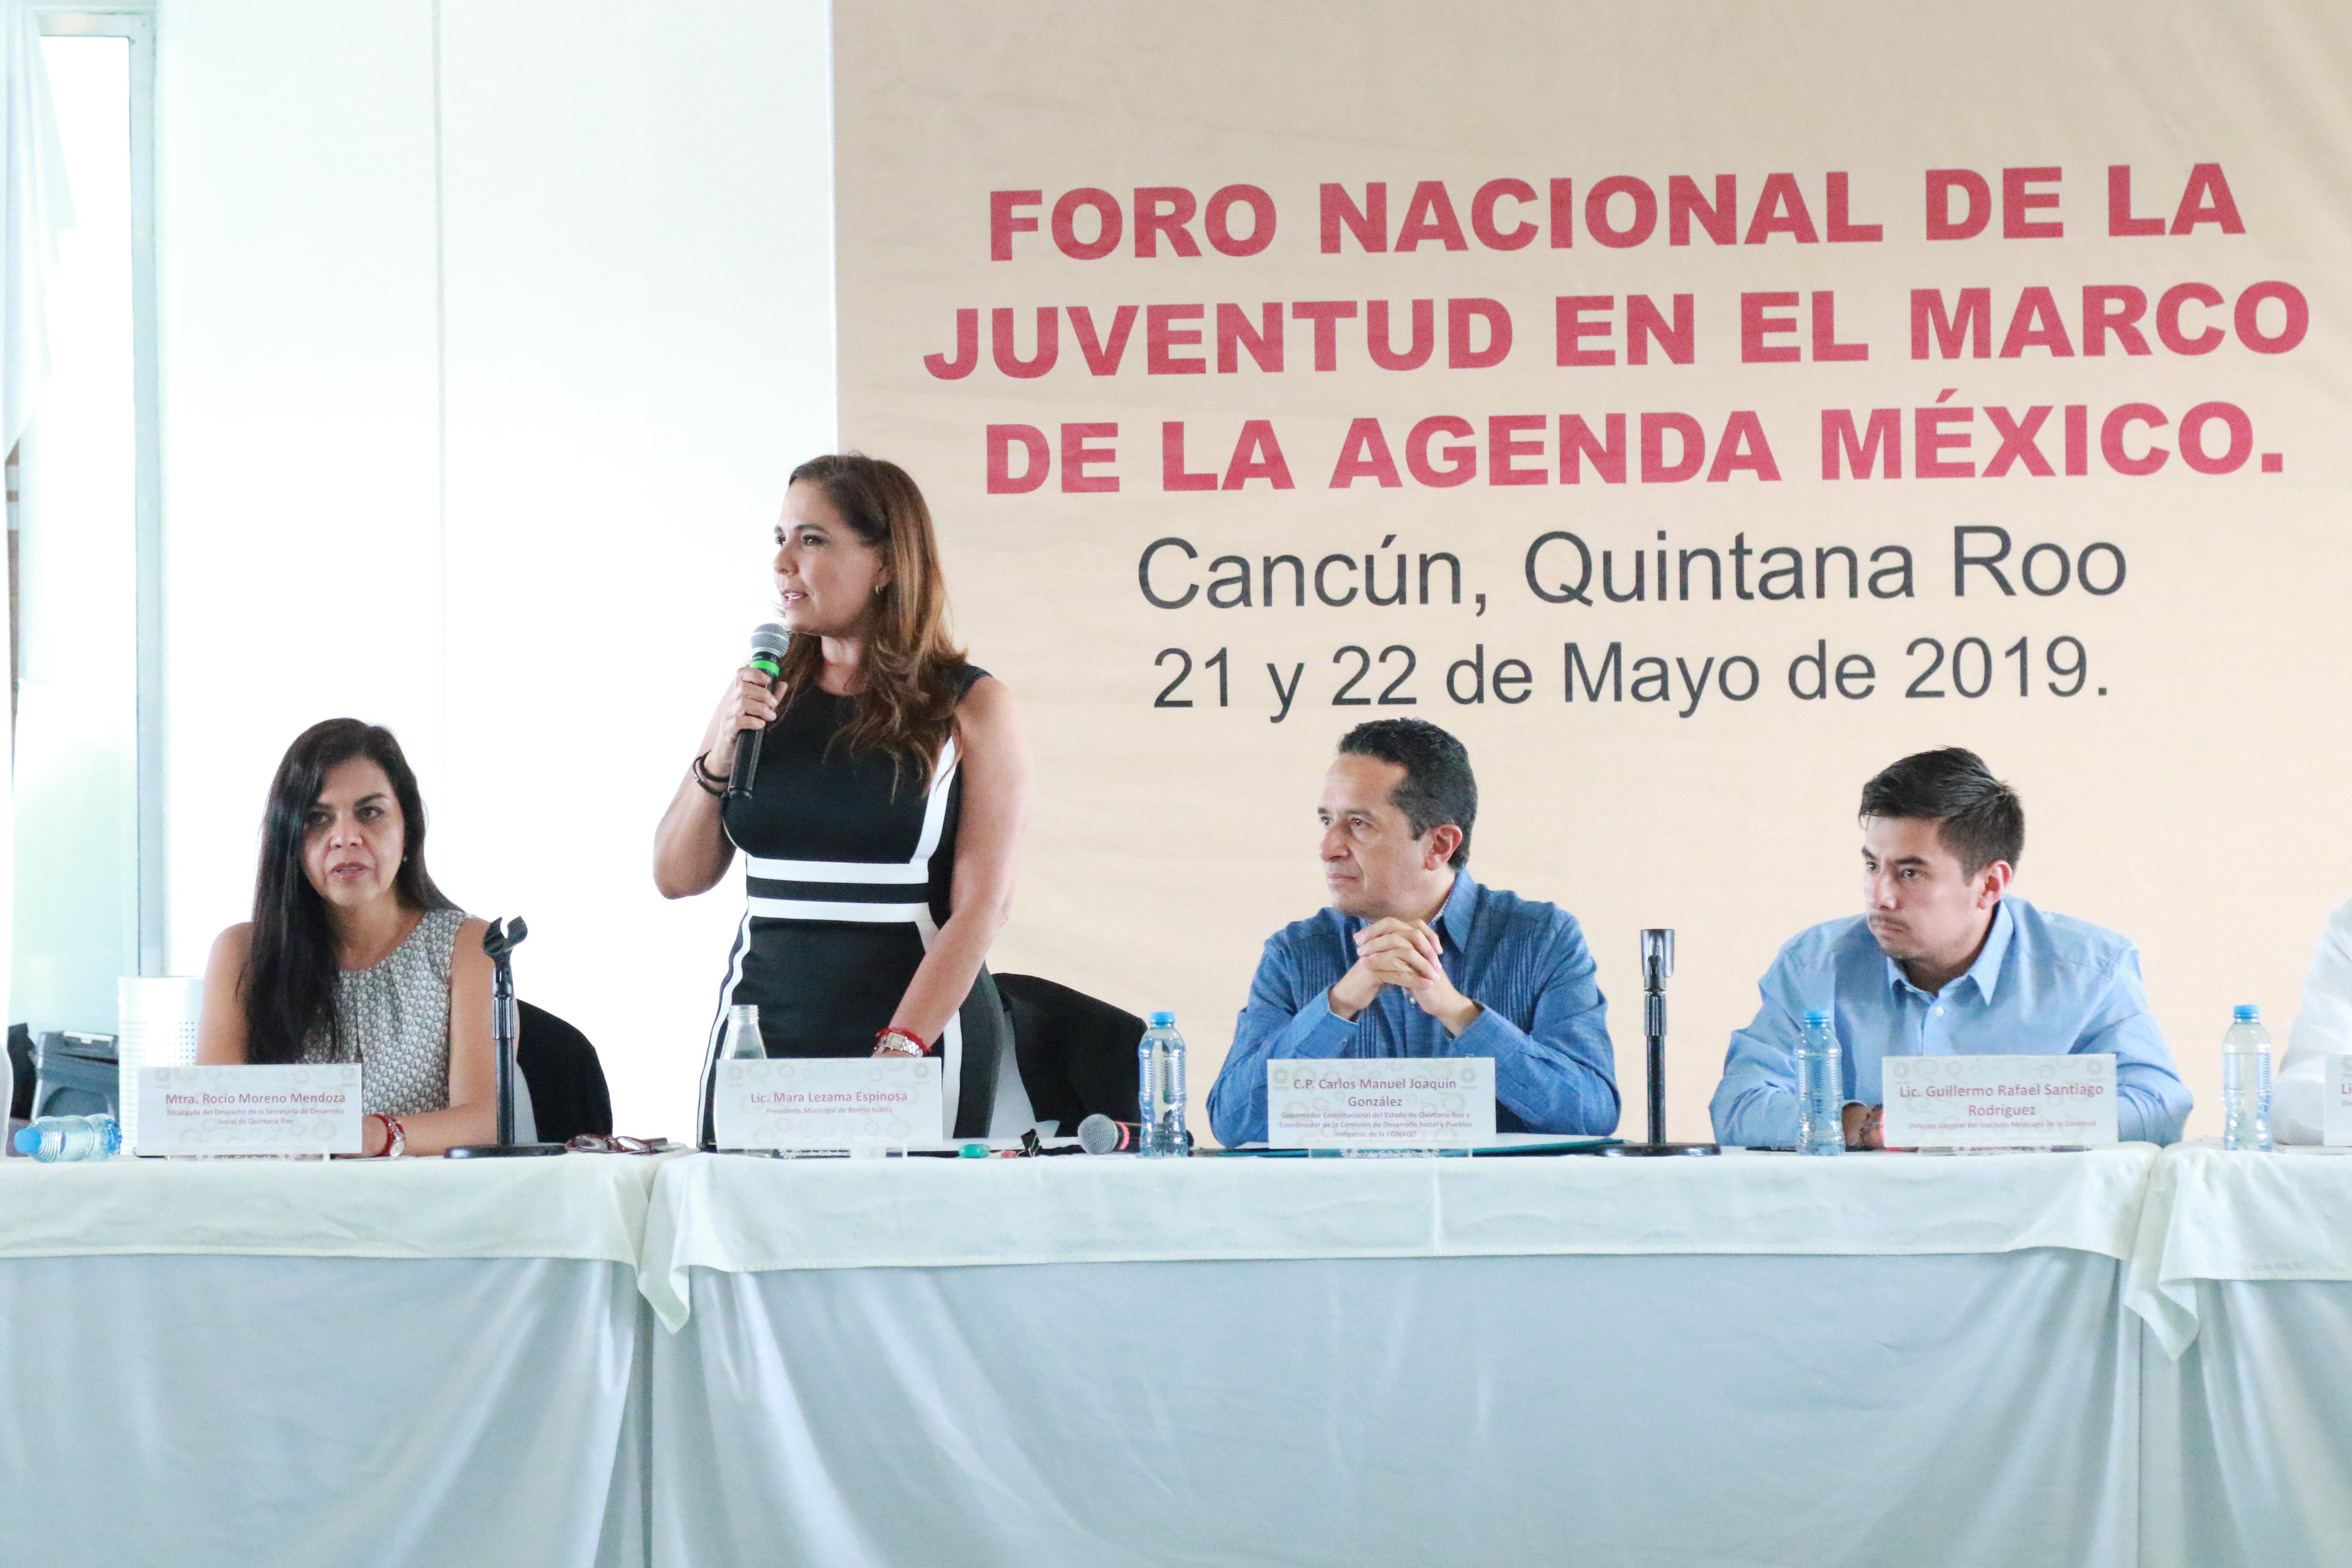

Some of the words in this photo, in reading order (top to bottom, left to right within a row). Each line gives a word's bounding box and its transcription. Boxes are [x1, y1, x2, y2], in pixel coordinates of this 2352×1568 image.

[991, 184, 1276, 260] FORO
[1320, 170, 1883, 257] NACIONAL
[1926, 167, 2064, 241] DE
[2108, 164, 2246, 236] LA
[925, 299, 1513, 380] JUVENTUD
[1556, 294, 1694, 366] EN
[1741, 291, 1868, 363] EL
[1911, 281, 2309, 360] MARCO
[986, 423, 1120, 494] DE
[1162, 420, 1295, 491] LA
[1329, 411, 1782, 488] AGENDA
[1822, 389, 2283, 480] MÉXICO.
[1138, 535, 1486, 616] Cancún,
[1525, 531, 1914, 606] Quintana
[1954, 526, 2125, 598] Roo
[1154, 647, 1228, 707] 21
[1266, 663, 1304, 723] y
[1332, 645, 1417, 705] 22
[1446, 644, 1532, 704] de
[1564, 643, 1759, 718] Mayo
[1788, 640, 1875, 700] de
[1905, 636, 2107, 698] 2019.
[1293, 1078, 1315, 1090] C.P.
[1318, 1078, 1356, 1090] Carlos
[1360, 1078, 1406, 1089] Manuel
[1409, 1078, 1457, 1091] Joaquín
[1900, 1086, 1922, 1098] Lic.
[1925, 1084, 1994, 1098] Guillermo
[1998, 1083, 2040, 1096] Rafael
[2044, 1083, 2104, 1098] Santiago
[165, 1094, 199, 1105] Mtra.
[202, 1093, 235, 1104] Rocío
[239, 1093, 287, 1104] Moreno
[290, 1092, 346, 1103] Mendoza
[750, 1092, 770, 1103] Lic.
[773, 1092, 805, 1103] Mara
[808, 1092, 852, 1103] Lezama
[856, 1091, 908, 1104] Espinosa
[1348, 1096, 1403, 1107] González
[1968, 1104, 2036, 1118] Rodríguez
